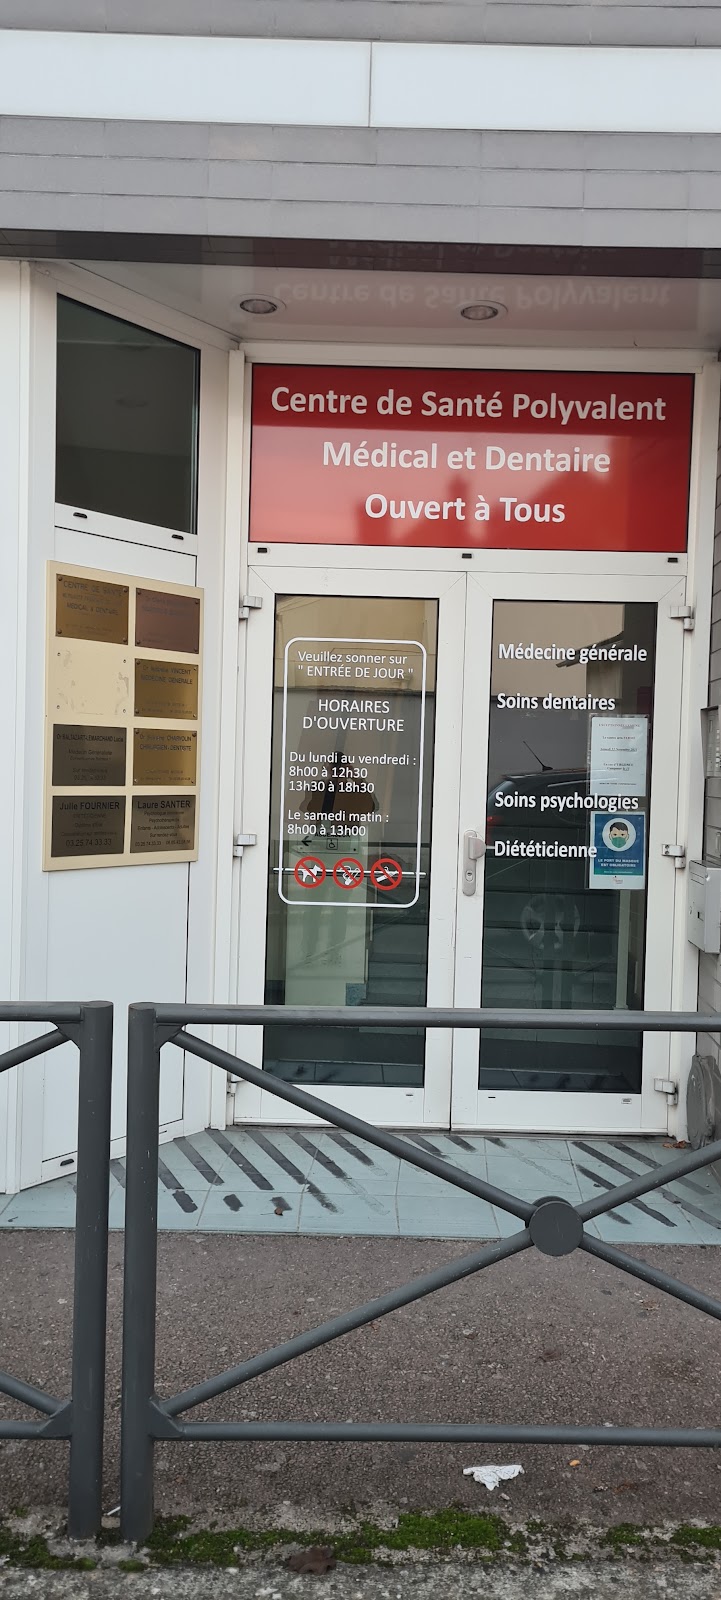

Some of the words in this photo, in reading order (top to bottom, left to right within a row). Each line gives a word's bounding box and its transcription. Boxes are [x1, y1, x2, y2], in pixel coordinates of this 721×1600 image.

[271, 386, 368, 414] Centre
[377, 389, 412, 416] de
[421, 390, 503, 418] Santé
[513, 392, 666, 424] Polyvalent
[323, 440, 438, 469] Médical
[447, 448, 476, 470] et
[485, 446, 611, 473] Dentaire
[365, 493, 466, 521] Ouvert
[474, 495, 491, 521] à
[499, 497, 566, 523] Tous
[63, 580, 88, 591] CENTRE
[297, 651, 342, 663] Veuillez
[345, 654, 385, 664] sonner
[389, 655, 408, 664] sur
[498, 643, 576, 660] Médecine
[579, 644, 648, 664] générale
[307, 665, 351, 677] ENTRÉE
[355, 668, 370, 678] DE
[373, 668, 405, 679] JOUR
[318, 699, 390, 714] HORAIRES
[496, 693, 539, 709] Soins
[542, 693, 616, 710] dentaires
[302, 716, 405, 731] D'OUVERTURE
[289, 752, 305, 762] Du
[309, 752, 338, 763] lundi
[340, 754, 355, 764] au
[358, 754, 410, 765] vendredi
[289, 766, 318, 777] 8h00
[321, 767, 328, 777] à
[331, 767, 368, 778] 12h30
[289, 780, 325, 792] 13h30
[328, 781, 335, 792] à
[338, 782, 375, 793] 18h30
[60, 801, 78, 810] Julie
[80, 801, 120, 810] FOURNIER
[137, 801, 159, 809] Laure
[160, 800, 191, 809] SANTER
[495, 791, 536, 808] Soins
[540, 792, 639, 812] psychologies
[288, 810, 301, 820] Le
[304, 811, 346, 821] samedi
[349, 812, 382, 823] matin
[287, 824, 317, 835] 8h00
[319, 825, 326, 836] à
[330, 825, 366, 836] 13h00
[494, 840, 597, 858] Diététicienne
